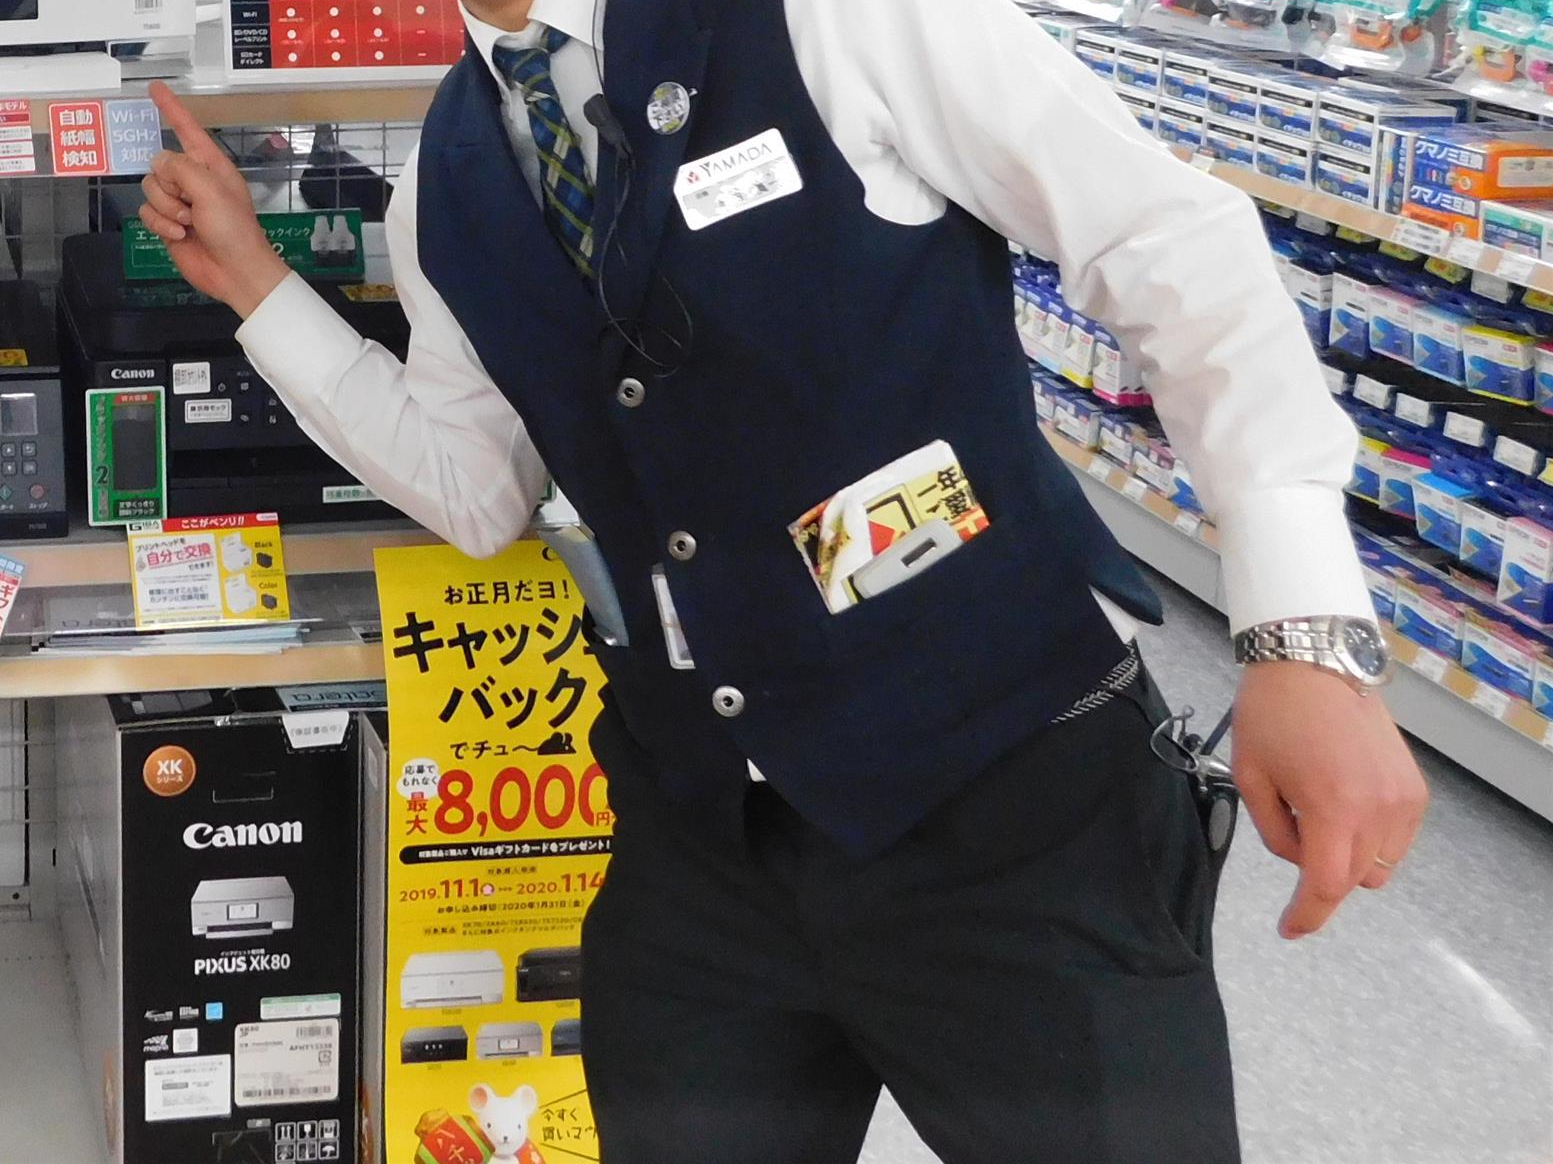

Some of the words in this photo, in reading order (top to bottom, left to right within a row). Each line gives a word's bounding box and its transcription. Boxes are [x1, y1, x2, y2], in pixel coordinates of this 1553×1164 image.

[58, 108, 94, 127] 自動
[111, 107, 155, 125] Wi-Fi
[60, 130, 96, 147] 紙幅
[112, 129, 159, 144] 5GHz
[62, 149, 98, 168] 検知
[699, 143, 772, 178] YAMADA
[110, 368, 155, 379] Canon
[180, 516, 245, 529] ここがベンリ!!
[146, 542, 212, 566] 自分で交換
[444, 579, 570, 605] お正月だヨ!
[392, 607, 596, 674] キャッシ
[438, 667, 588, 730] バック
[156, 759, 183, 775] XK
[155, 774, 184, 784] シリーズ
[405, 791, 429, 836] 最大
[433, 762, 609, 837] 8,000
[182, 820, 303, 849] Canon
[194, 956, 248, 976] PIXUS
[249, 953, 291, 972] XK80
